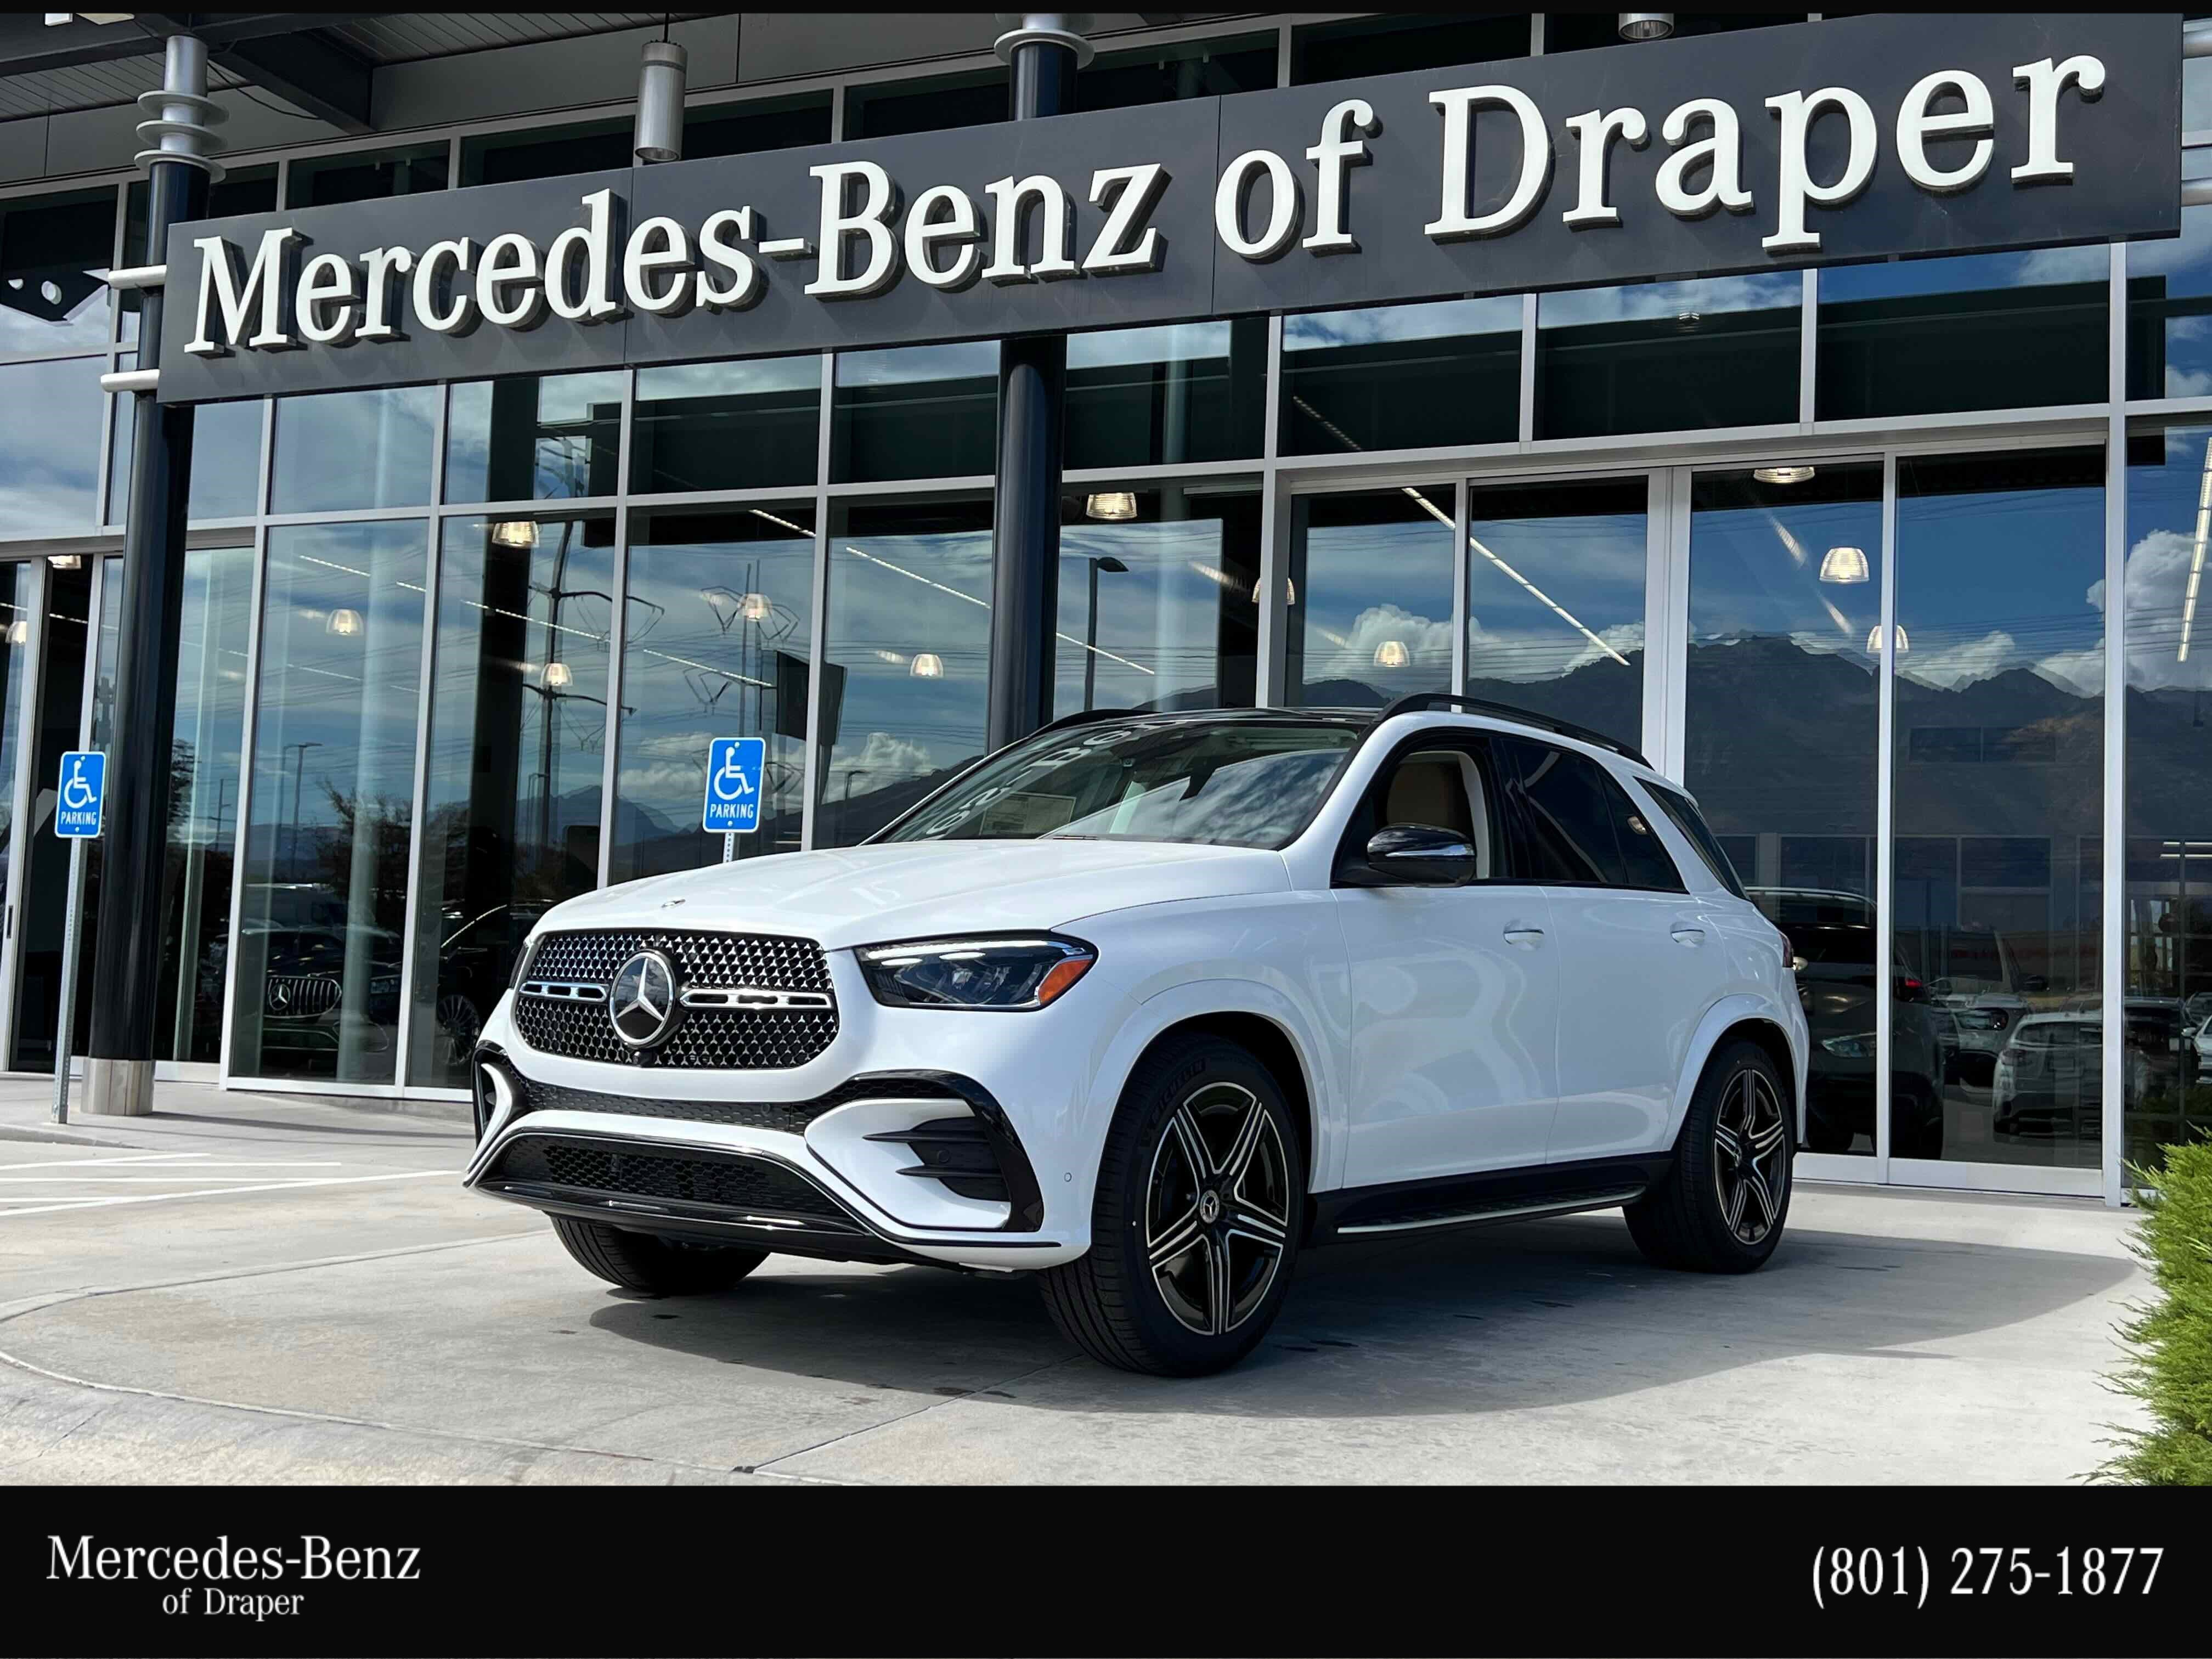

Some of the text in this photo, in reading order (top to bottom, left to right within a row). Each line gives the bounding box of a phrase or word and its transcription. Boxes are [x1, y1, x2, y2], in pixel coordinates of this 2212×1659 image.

[184, 54, 2106, 356] Mercedes-Benz of Draper
[60, 811, 97, 825] PARKING
[709, 803, 754, 819] PARKING
